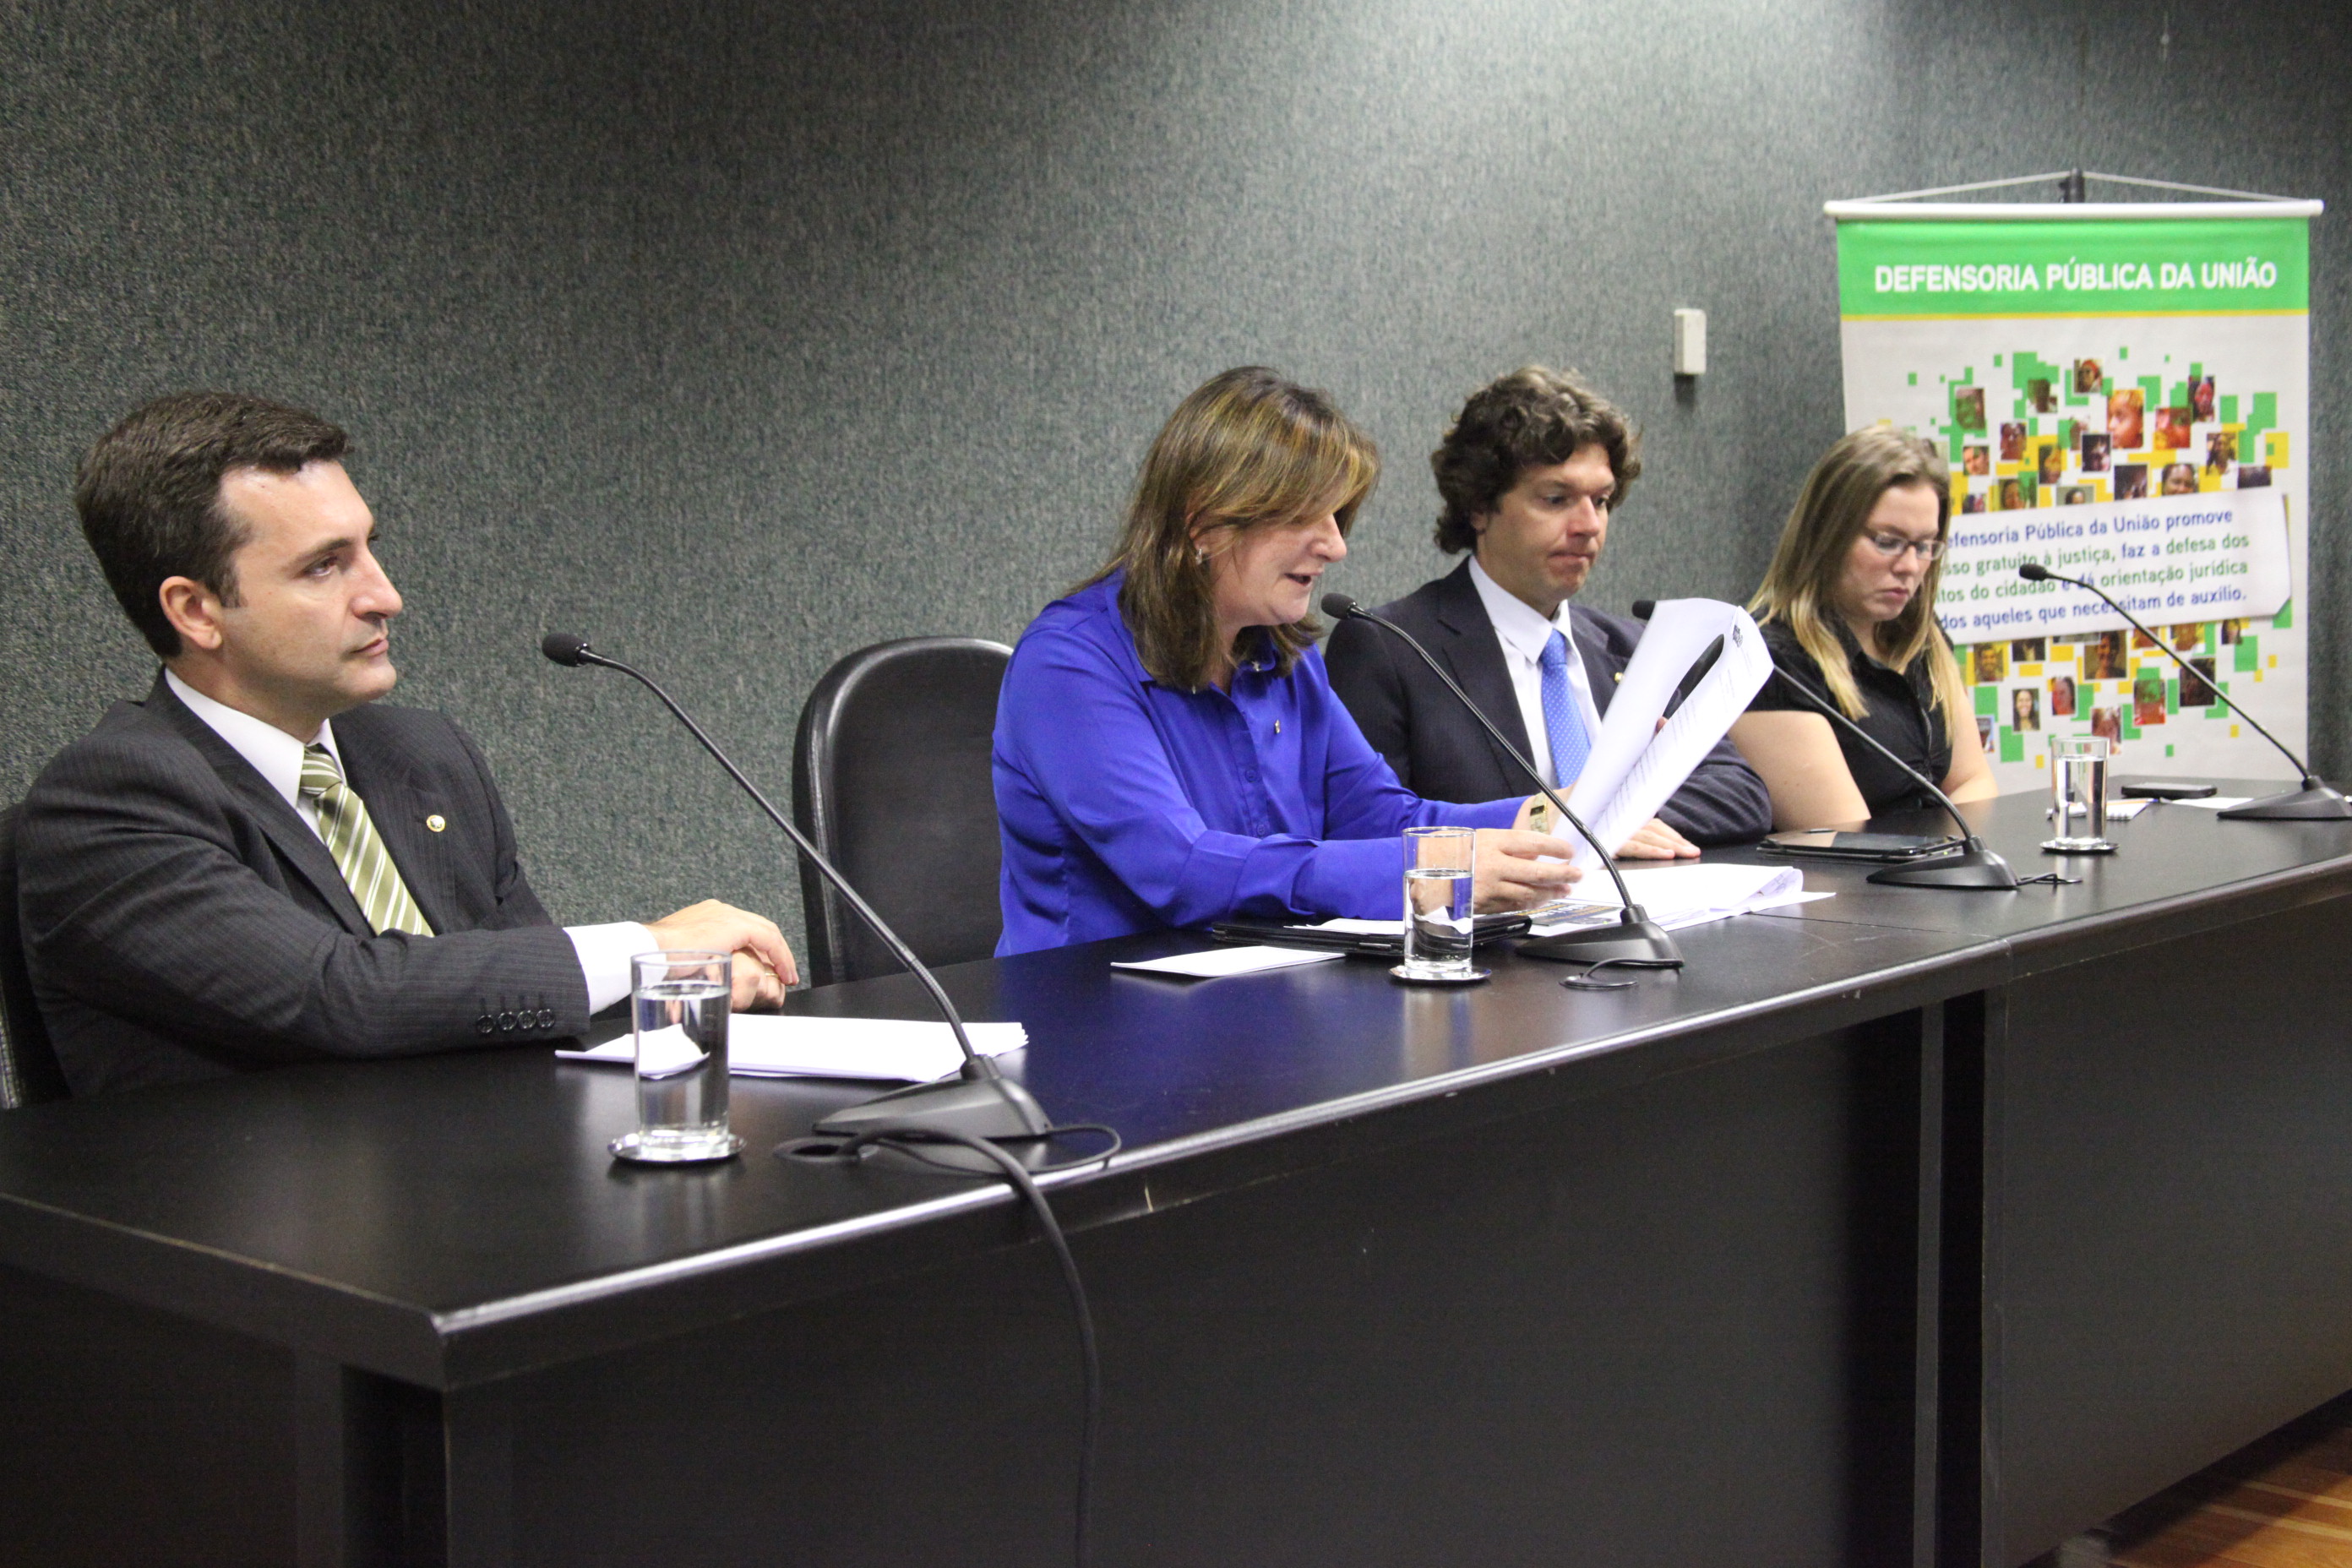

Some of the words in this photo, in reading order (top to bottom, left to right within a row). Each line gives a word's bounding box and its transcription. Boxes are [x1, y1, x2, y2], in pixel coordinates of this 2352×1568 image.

[1875, 264, 2040, 292] DEFENSORIA
[2046, 256, 2153, 291] PÚBLICA
[2159, 263, 2195, 290] DA
[2201, 256, 2278, 289] UNIÃO
[1946, 525, 2018, 549] efensoria
[2025, 520, 2083, 542] Pública
[2089, 517, 2108, 536] da
[2114, 514, 2160, 534] União
[2166, 510, 2233, 534] promove
[2058, 545, 2115, 570] justiça,
[2121, 541, 2146, 559] faz
[2152, 543, 2160, 557] a
[2166, 538, 2216, 555] defesa
[2222, 532, 2250, 549] dos
[1970, 581, 1990, 601] do
[2100, 565, 2184, 588] orientação
[2190, 558, 2249, 584] jurídica
[1973, 606, 2033, 631] aqueles
[2039, 606, 2066, 625] que
[2166, 591, 2185, 607] de
[2191, 584, 2248, 606] auxílio.
